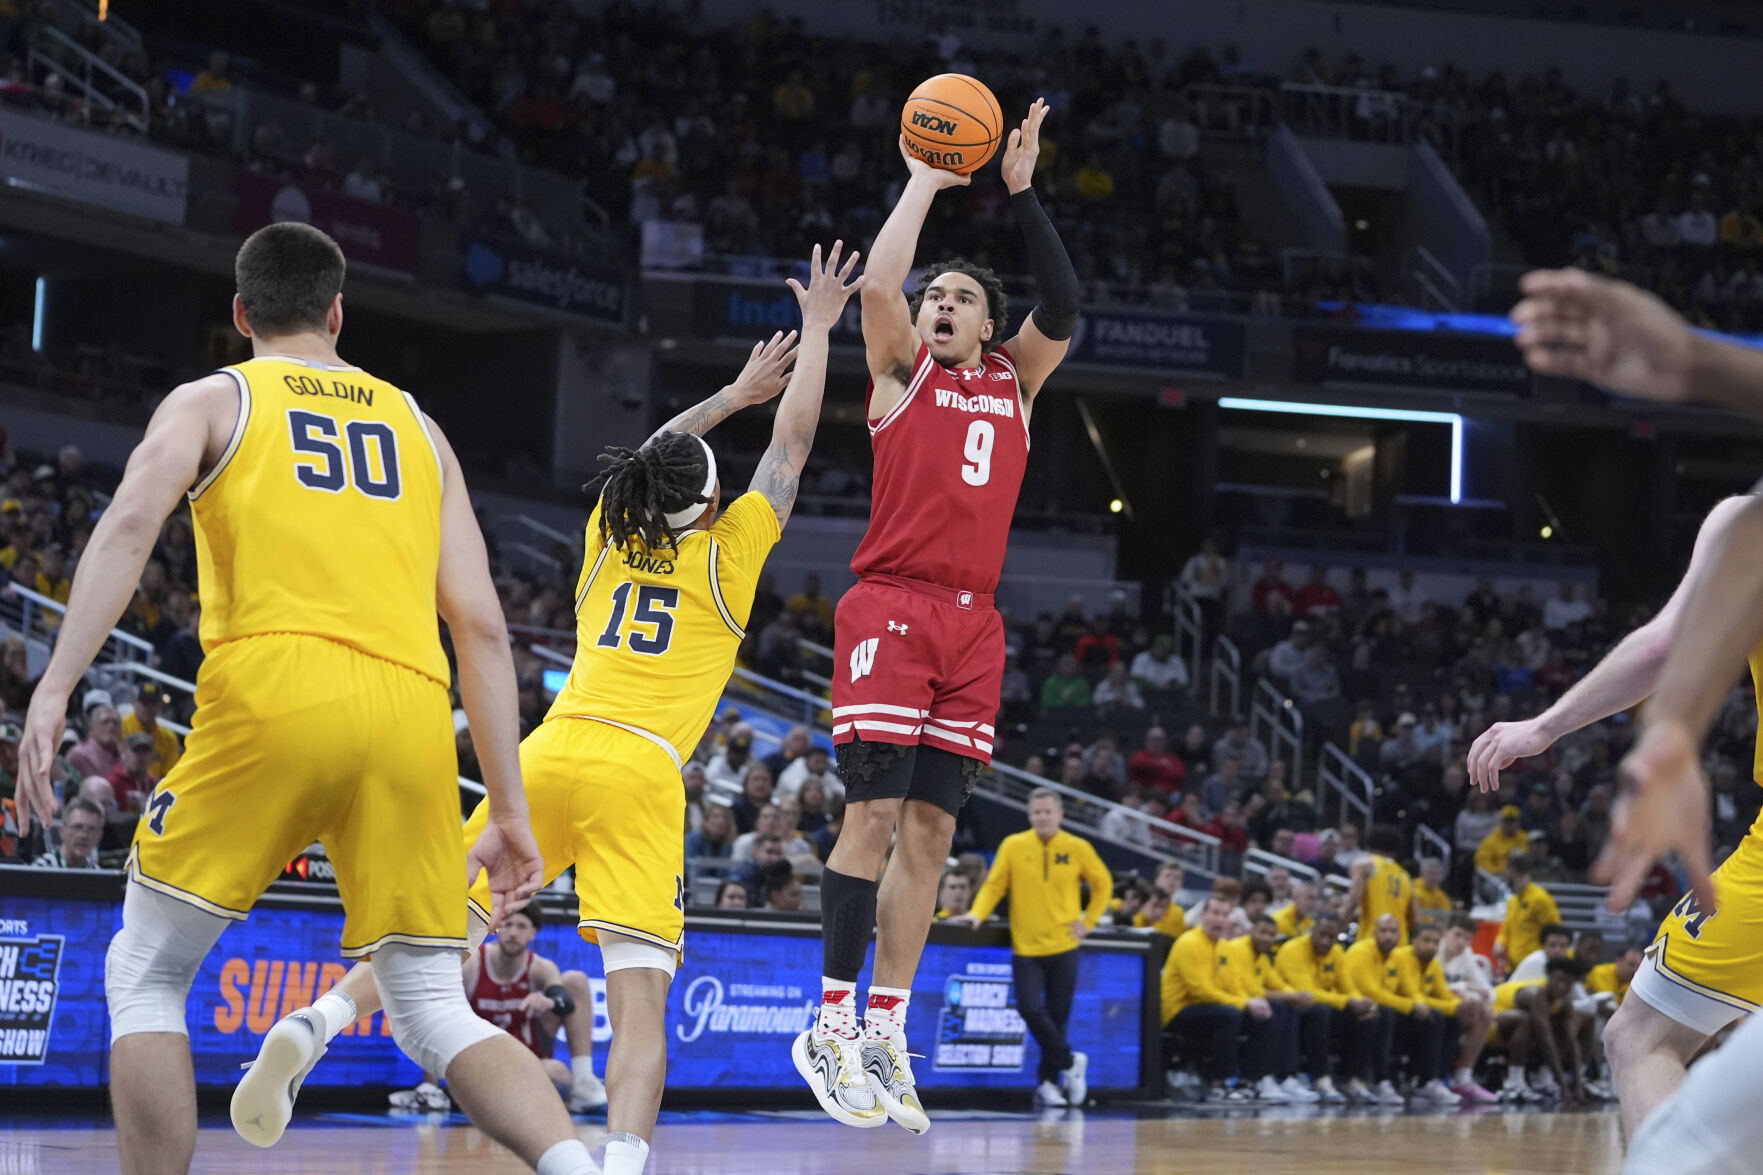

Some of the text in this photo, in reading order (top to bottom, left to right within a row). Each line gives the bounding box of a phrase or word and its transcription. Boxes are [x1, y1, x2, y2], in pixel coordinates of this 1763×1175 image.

[912, 110, 958, 136] NCAA
[283, 375, 374, 407] GOLDIN
[286, 408, 402, 502] 50
[961, 419, 995, 487] 9
[622, 551, 675, 575] JONES
[597, 580, 681, 657] 15
[850, 637, 880, 684] W
[676, 975, 814, 1042] Paramount
